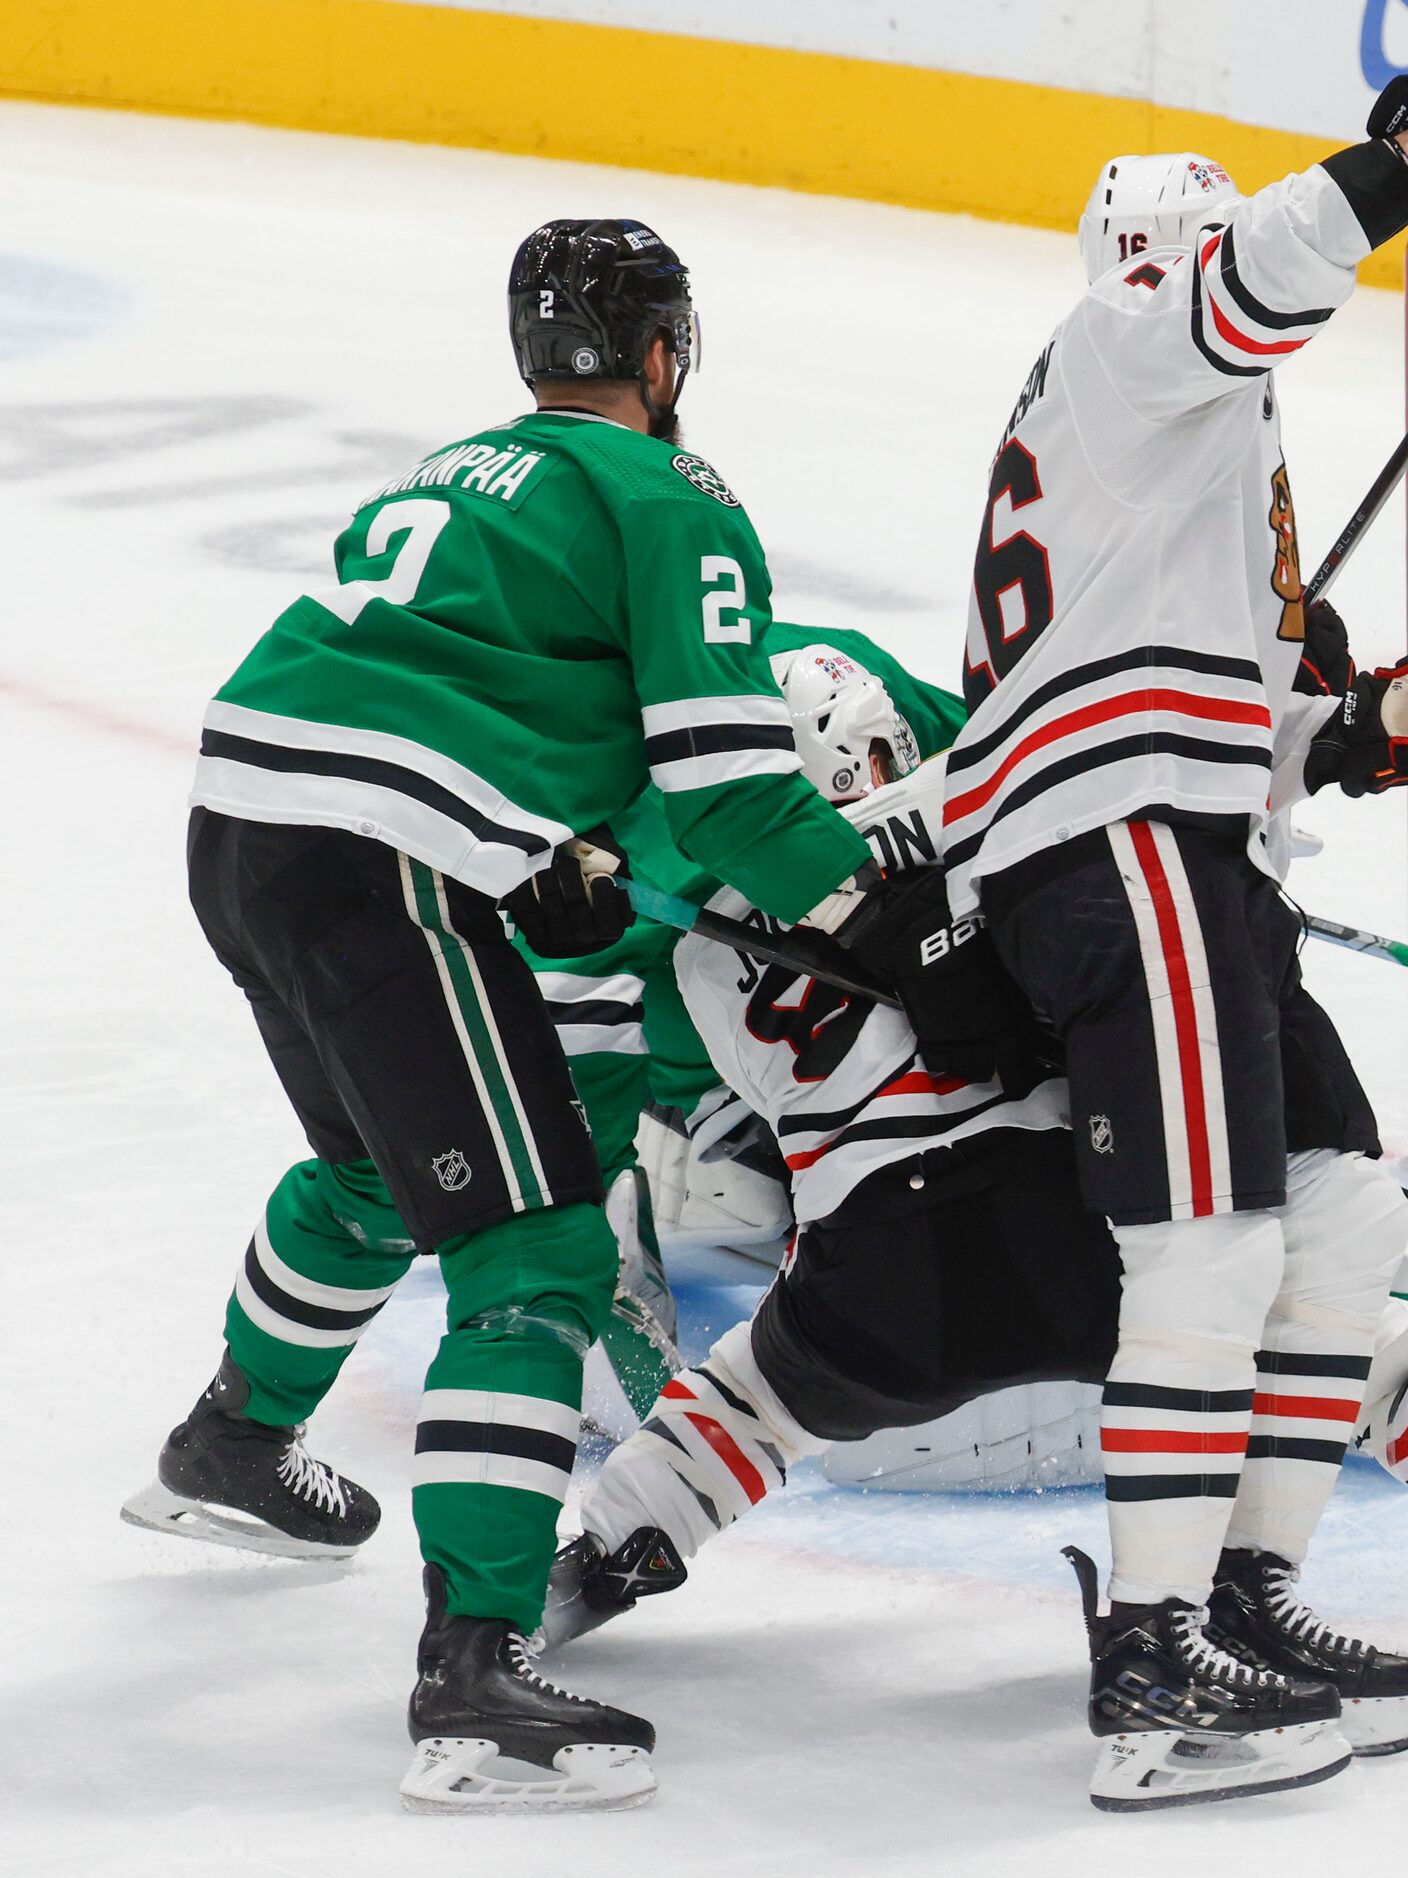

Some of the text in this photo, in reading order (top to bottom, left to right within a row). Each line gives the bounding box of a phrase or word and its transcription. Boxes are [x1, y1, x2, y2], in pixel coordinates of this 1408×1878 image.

[1118, 233, 1148, 263] 16
[539, 290, 554, 319] 2
[700, 555, 752, 645] 2
[1343, 691, 1354, 726] CCM
[1116, 1670, 1219, 1727] CCM
